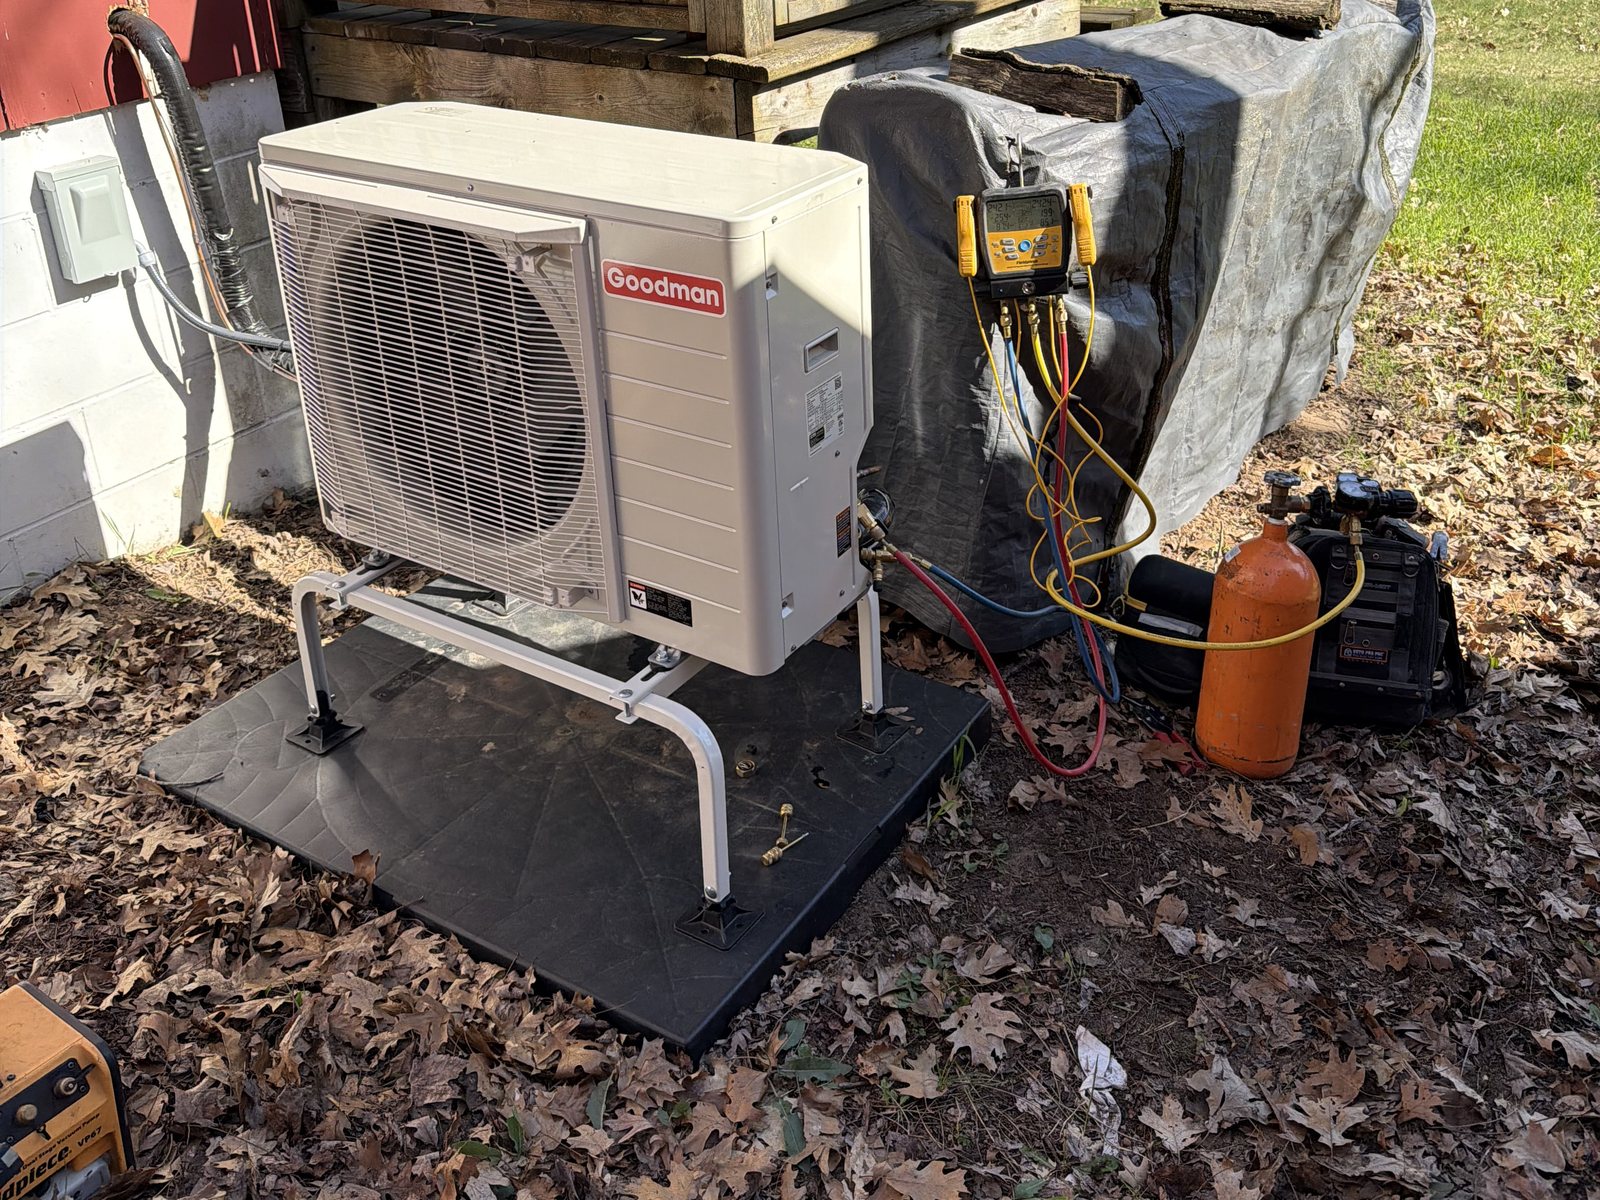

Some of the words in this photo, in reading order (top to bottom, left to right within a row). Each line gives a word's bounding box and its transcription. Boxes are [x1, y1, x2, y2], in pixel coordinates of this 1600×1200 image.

[607, 267, 720, 307] Goodman
[38, 1144, 56, 1159] Stage
[57, 1126, 82, 1145] Vacuum
[82, 1113, 100, 1127] Pump
[77, 1126, 102, 1147] VP67
